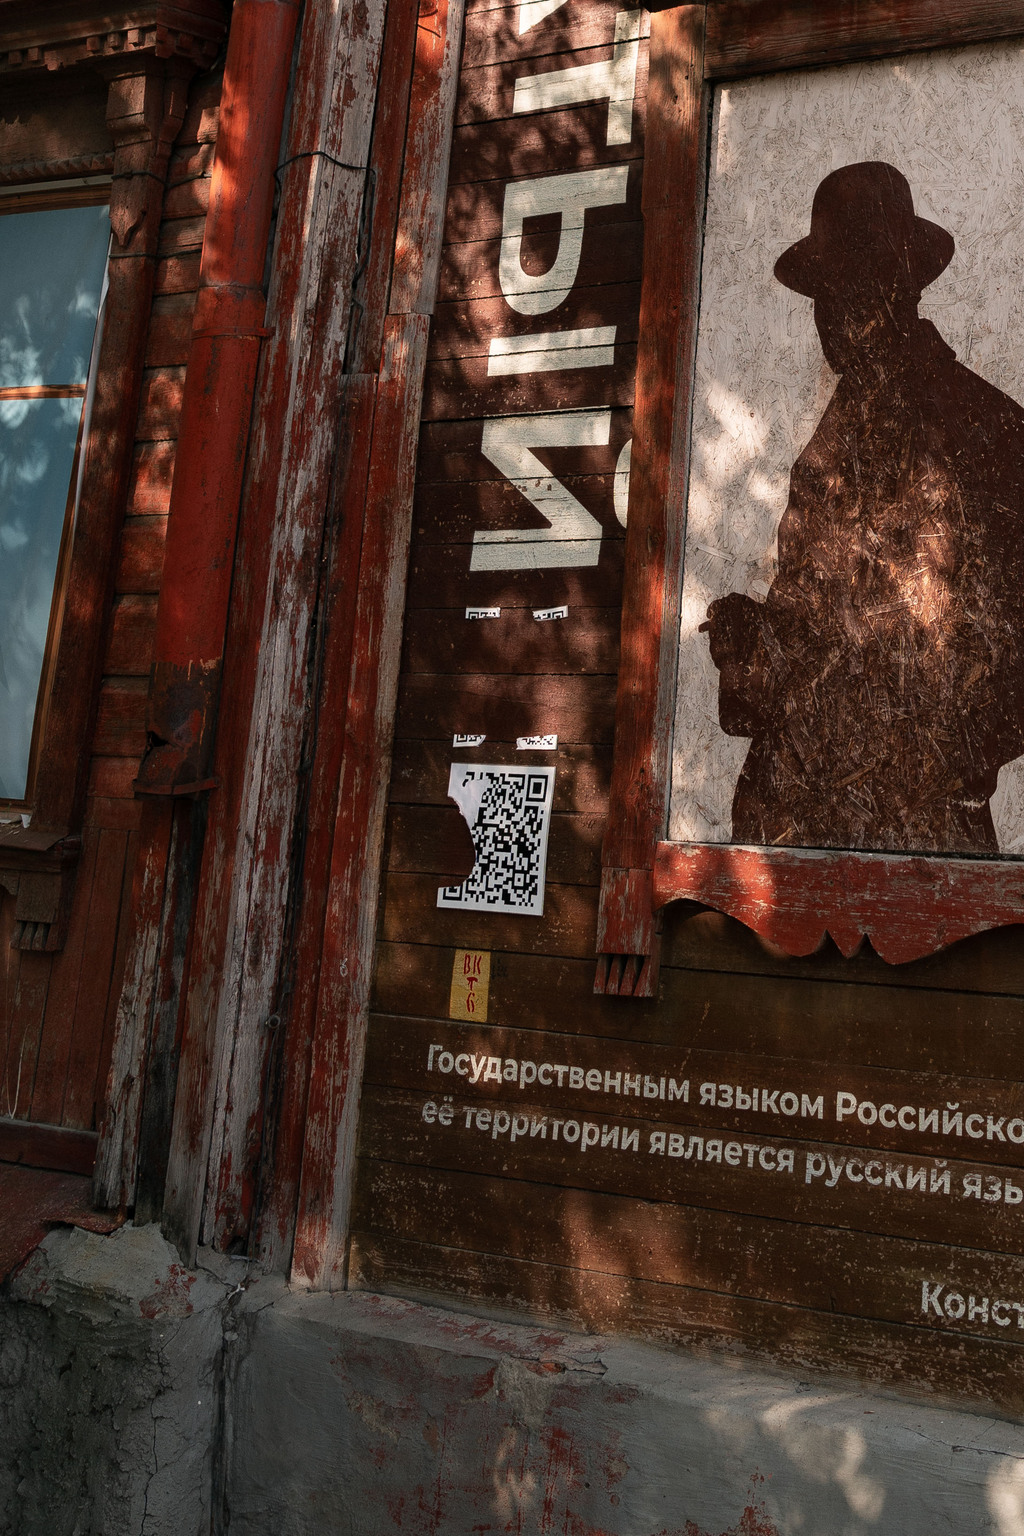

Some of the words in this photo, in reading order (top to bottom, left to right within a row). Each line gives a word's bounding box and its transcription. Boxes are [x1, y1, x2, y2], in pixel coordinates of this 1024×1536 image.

[427, 1044, 690, 1103] Государственным
[699, 1081, 824, 1120] языком
[421, 1096, 454, 1125] её
[463, 1106, 640, 1153] территории
[648, 1128, 796, 1174] является
[804, 1148, 951, 1195] русский
